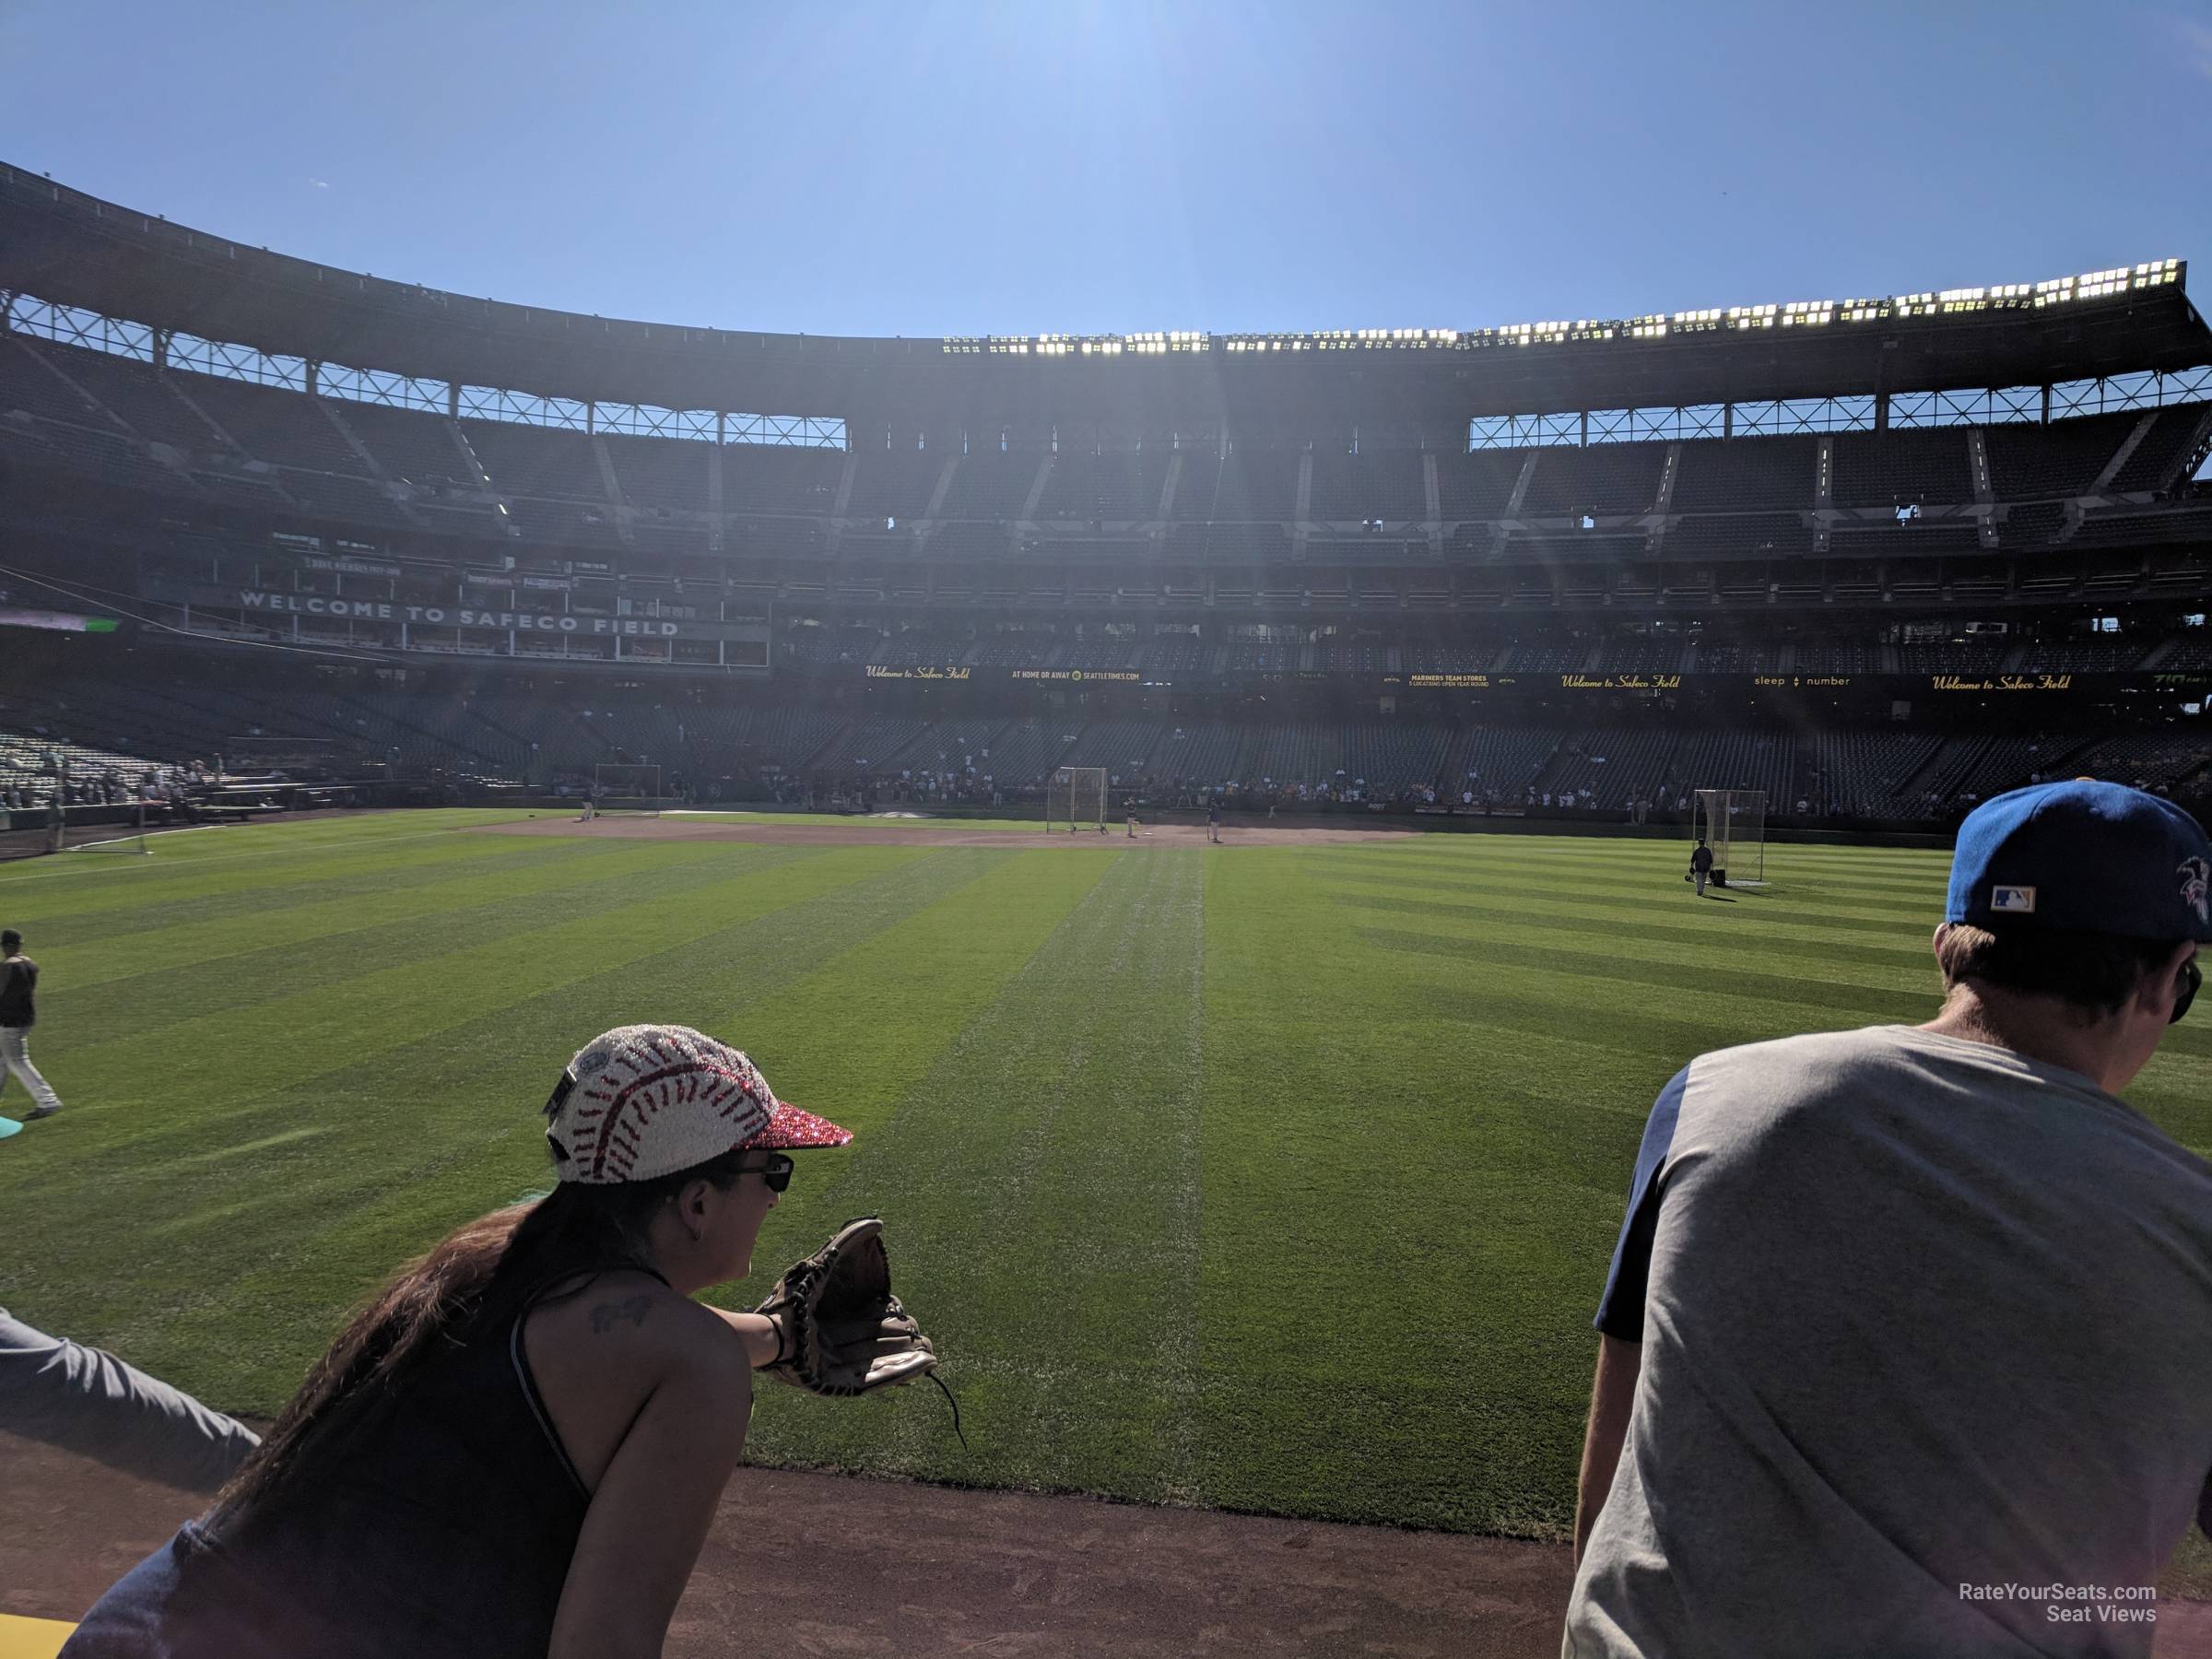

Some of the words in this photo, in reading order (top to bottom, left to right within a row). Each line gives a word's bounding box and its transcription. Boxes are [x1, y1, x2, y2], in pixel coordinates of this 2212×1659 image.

[239, 590, 393, 619] WELCOME
[406, 606, 444, 623] TO
[460, 611, 578, 631] SAFECO
[594, 620, 679, 636] FIELD
[865, 665, 903, 678] Welcome
[904, 669, 912, 678] to
[913, 666, 944, 679] Safeco
[945, 666, 971, 679] Field
[1083, 672, 1140, 680] SEATTLETIMES.COM
[1562, 675, 1603, 688] Welcome
[1605, 677, 1613, 688] to
[1615, 675, 1649, 688] Safeco
[1651, 675, 1681, 688] Field
[1754, 676, 1785, 688] sleep
[1806, 676, 1850, 686] number
[1932, 675, 1981, 689] Welcome
[1983, 678, 1994, 689] to
[1994, 675, 2034, 690] Safeco
[2038, 675, 2072, 690] Field
